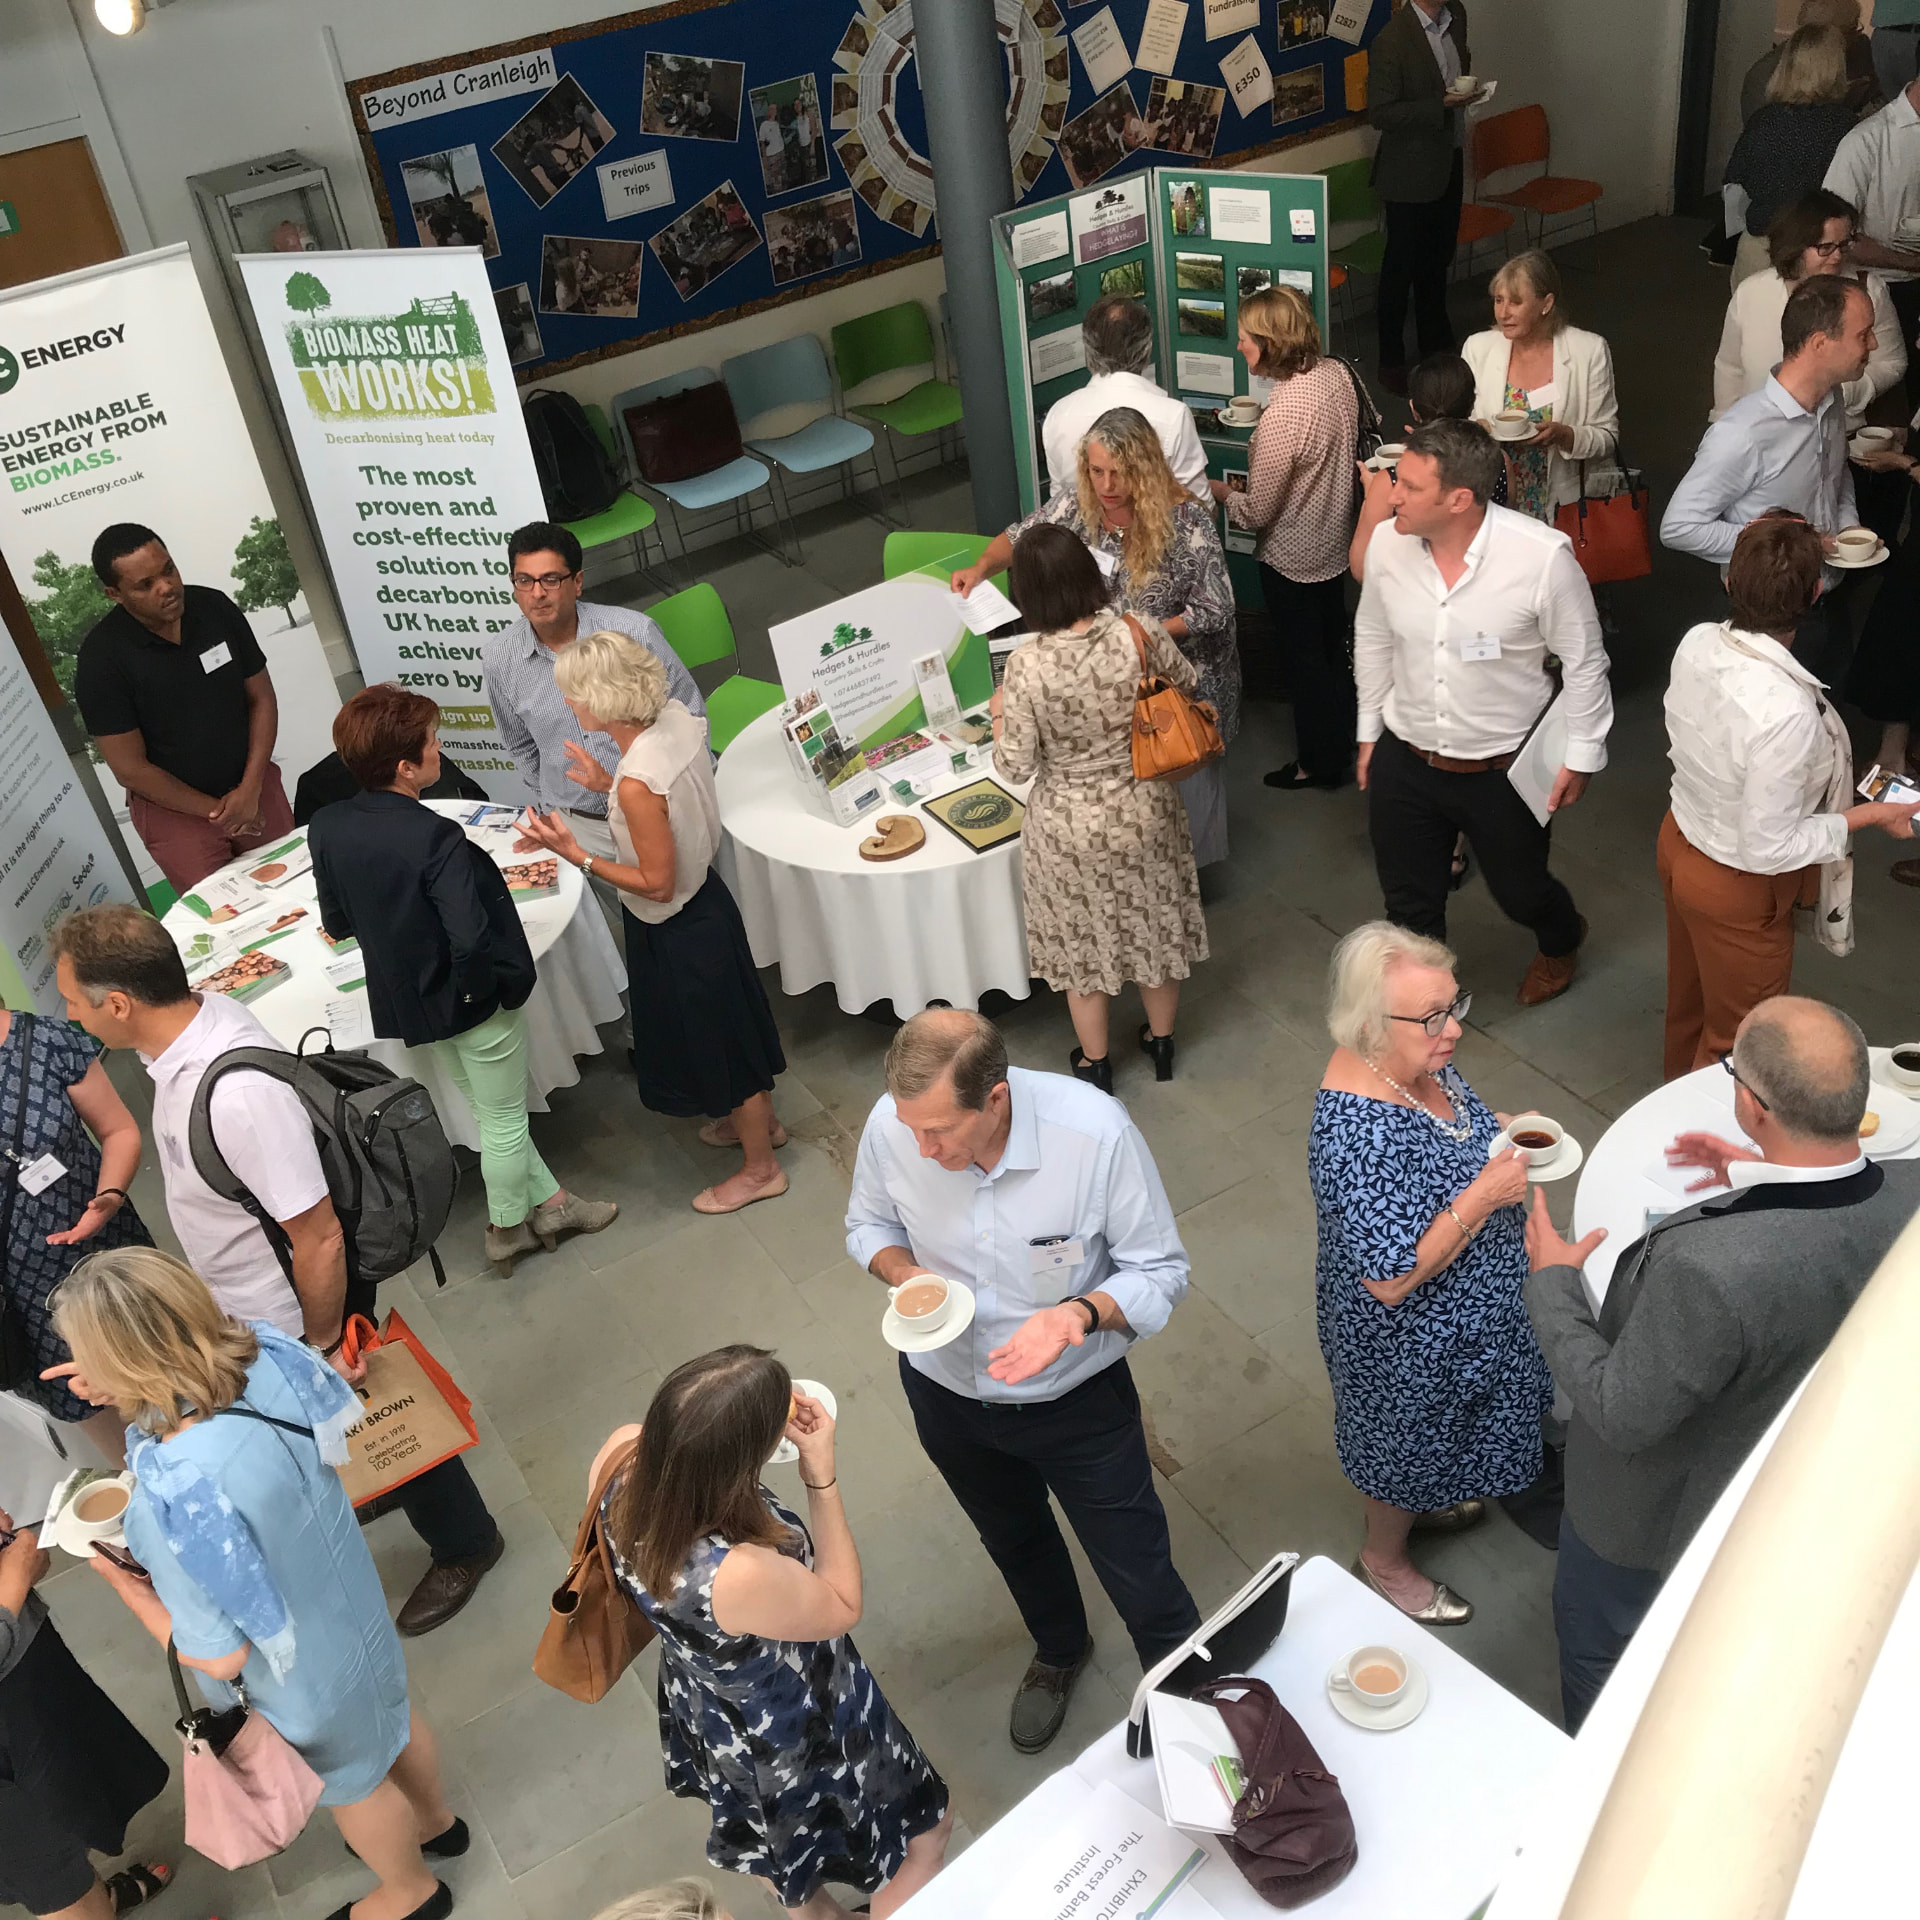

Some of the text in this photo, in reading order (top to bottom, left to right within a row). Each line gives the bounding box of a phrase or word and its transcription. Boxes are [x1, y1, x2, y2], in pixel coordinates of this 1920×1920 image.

[364, 55, 551, 118] Beyond Cranleigh
[1235, 67, 1261, 94] £350
[610, 161, 656, 180] Previous
[623, 181, 651, 197] Trips
[21, 323, 126, 369] ENERGY
[303, 324, 460, 358] BIOMASS HEAT
[312, 358, 476, 412] WORKS!
[0, 393, 154, 453] SUSTAINABLE
[1, 410, 168, 473] ENERGY FROM
[326, 432, 496, 447] Decarbonising heat today
[9, 447, 123, 493] BIOMASS.
[358, 465, 477, 486] The most
[21, 470, 145, 516] www.LCEnergy.co.uk
[356, 496, 498, 521] proven and
[353, 527, 512, 546] cost-effective
[376, 556, 509, 576] solution to
[383, 612, 422, 632] UK
[423, 613, 480, 633] heat
[812, 642, 891, 679] Hedges & Hurdles
[398, 669, 483, 693] zero by
[470, 711, 490, 727] up
[8, 855, 17, 867] is
[15, 841, 27, 858] the
[25, 821, 41, 844] right
[38, 802, 57, 825] thing
[54, 793, 63, 805] to
[62, 782, 73, 795] do.
[14, 837, 66, 909] www.LCEnergy.co.uk
[366, 1395, 416, 1427] BROWN
[364, 1424, 406, 1452] Est. in 1919
[368, 1434, 417, 1465] Celebrating
[373, 1441, 422, 1473] 100 Years
[1118, 1831, 1144, 1853] The
[1053, 1845, 1102, 1893] Institute
[1085, 1852, 1123, 1891] Forest
